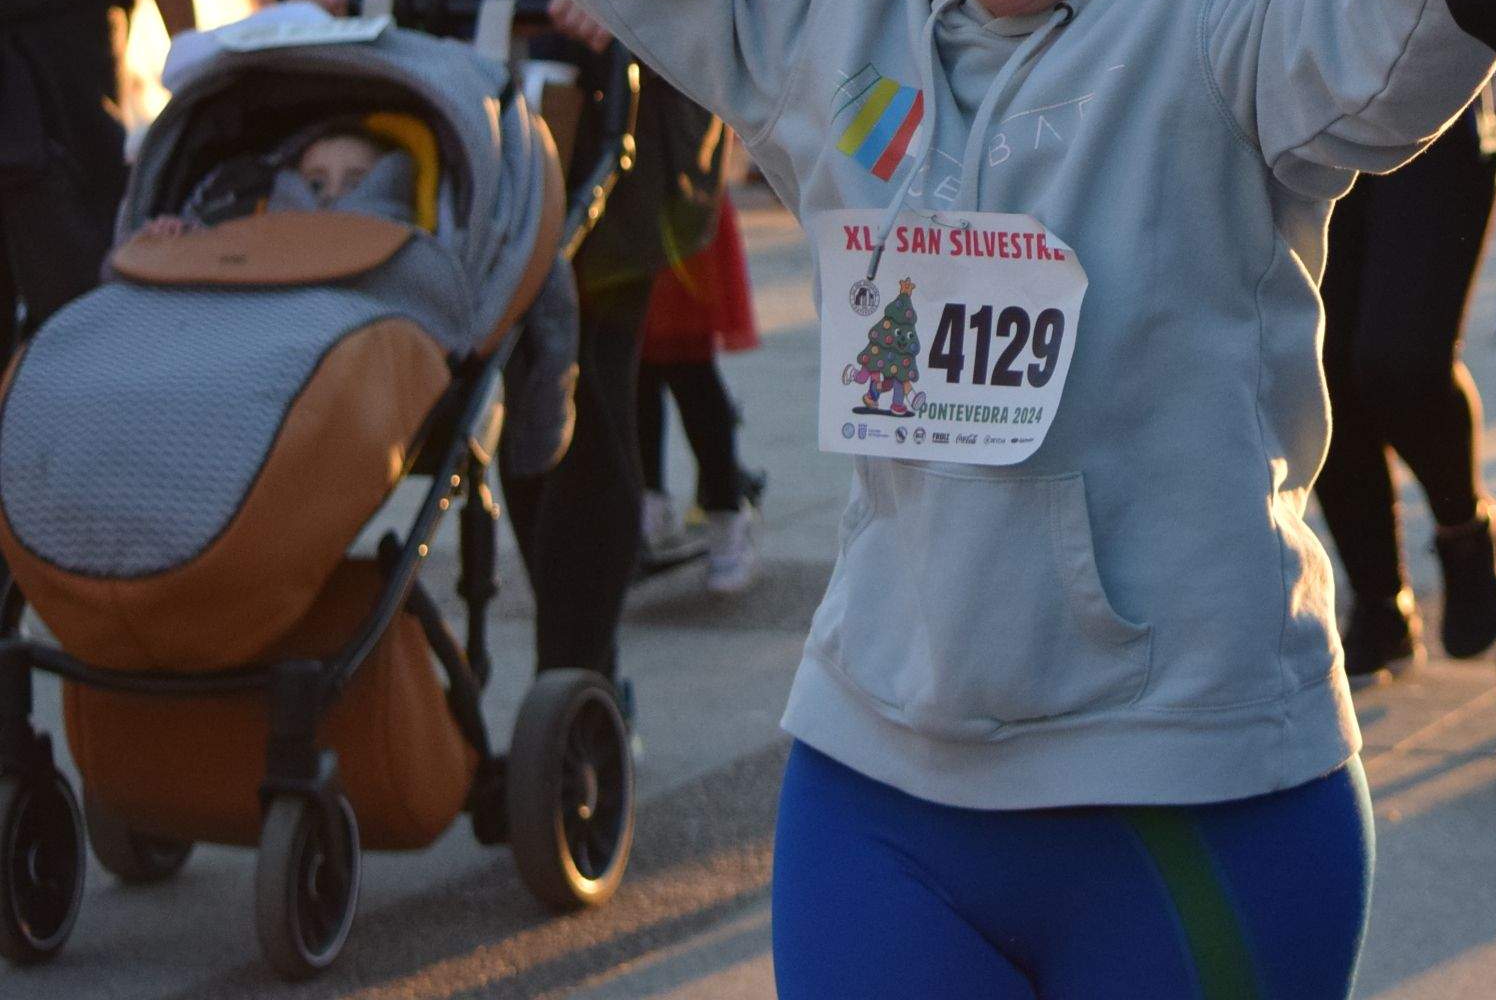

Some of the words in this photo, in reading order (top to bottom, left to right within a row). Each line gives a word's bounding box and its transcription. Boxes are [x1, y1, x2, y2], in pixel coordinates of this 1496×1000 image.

[896, 226, 942, 255] SAN
[927, 302, 1066, 389] 4129
[917, 402, 1008, 424] PONTEVEDRA
[1012, 406, 1044, 424] 2024
